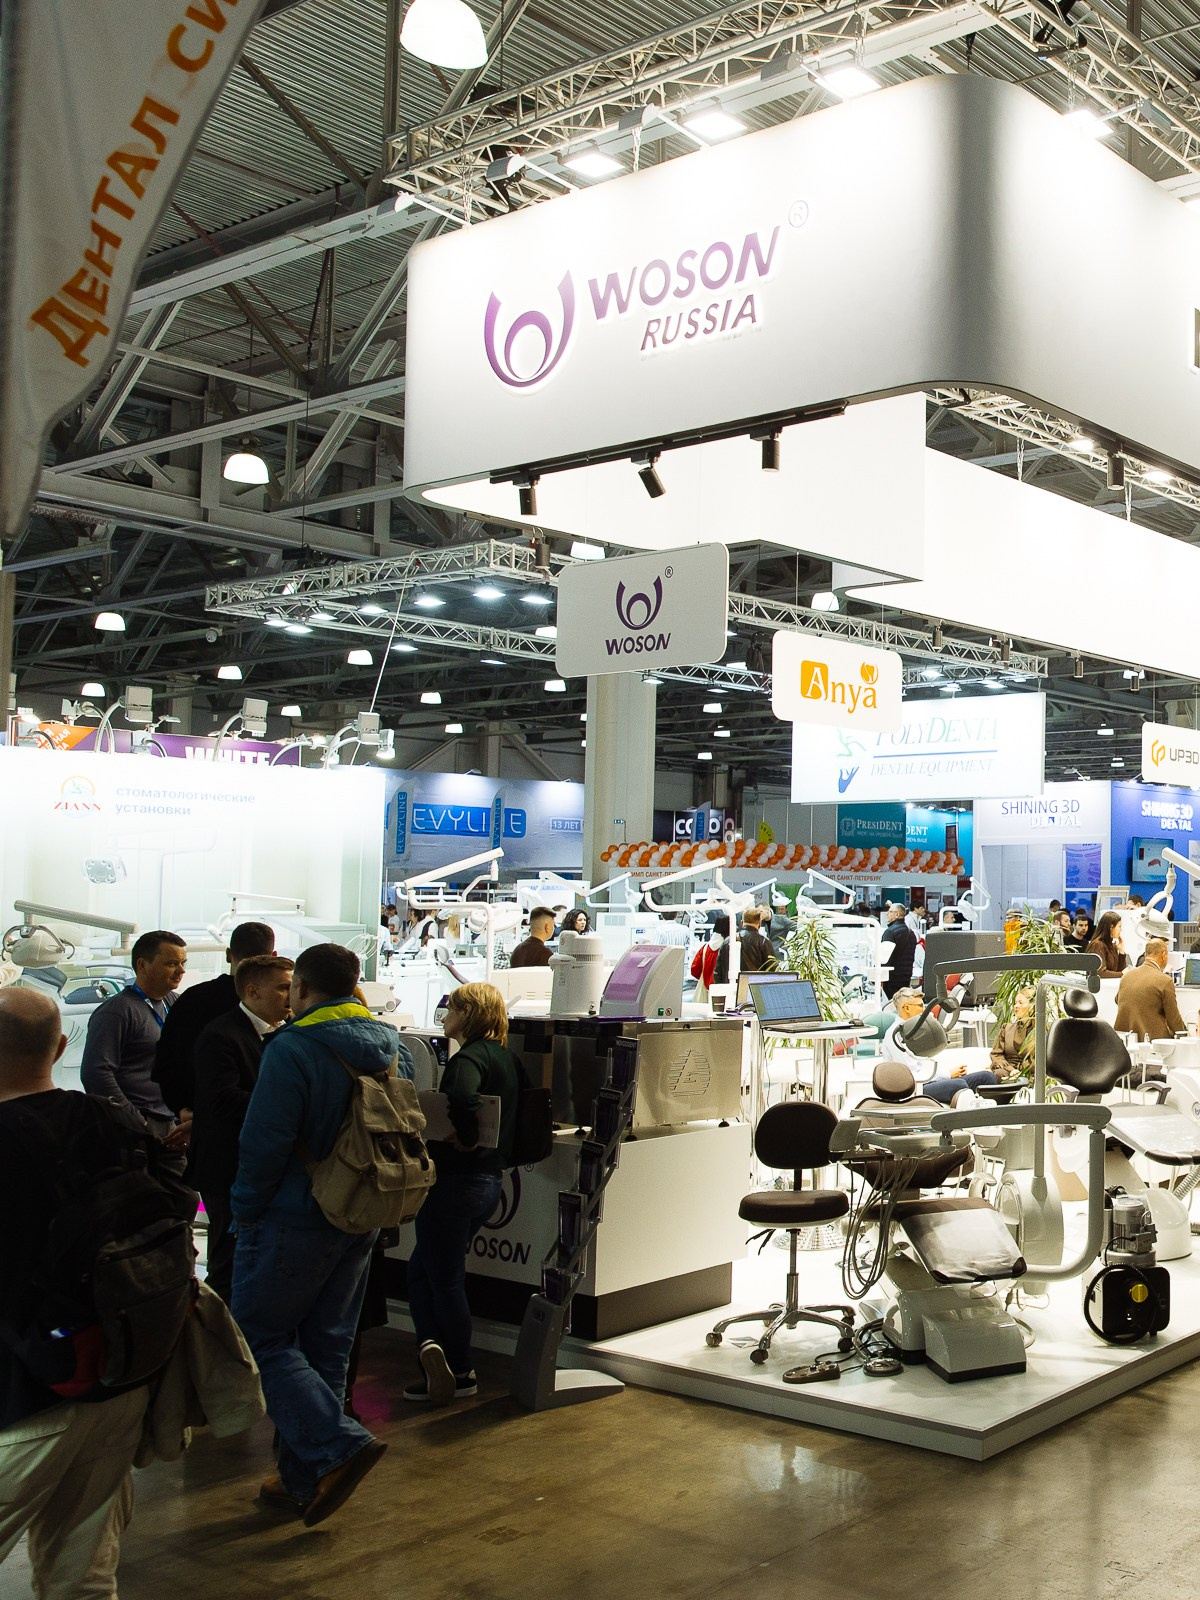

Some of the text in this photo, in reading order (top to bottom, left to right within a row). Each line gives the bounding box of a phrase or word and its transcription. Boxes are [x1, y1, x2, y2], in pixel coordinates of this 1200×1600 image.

[31, 97, 180, 367] ДЕНТАЛ
[587, 225, 782, 320] WOSON
[640, 294, 758, 351] RUSSIA
[605, 632, 671, 655] WOSON
[801, 660, 877, 714] Anya
[1169, 748, 1200, 765] UP3D
[870, 758, 994, 777] DENTAL EQUIPMENT
[116, 786, 255, 804] стоматологические
[115, 803, 191, 816] установки
[1001, 799, 1081, 816] SHINING 3D
[1141, 800, 1194, 820] SHINING 3D
[412, 808, 522, 834] EVYLIE
[493, 802, 501, 848] EVYLINE
[552, 821, 580, 831] 13 ЛЕТ
[675, 817, 720, 835] COO
